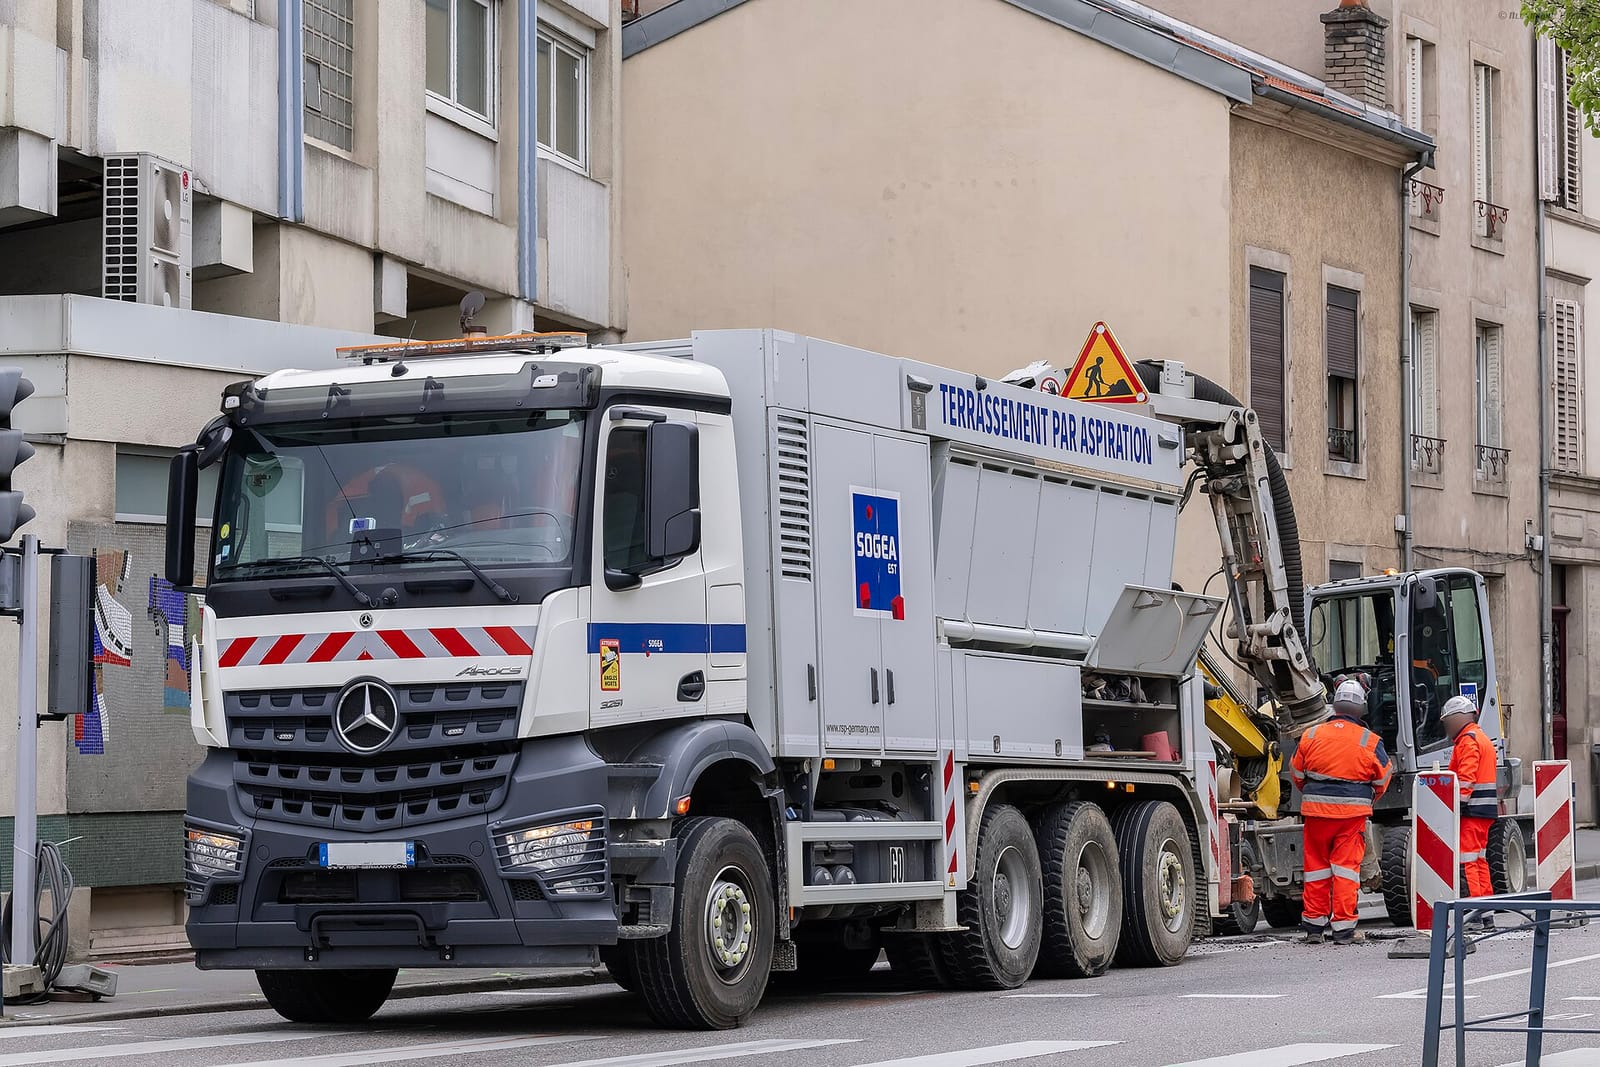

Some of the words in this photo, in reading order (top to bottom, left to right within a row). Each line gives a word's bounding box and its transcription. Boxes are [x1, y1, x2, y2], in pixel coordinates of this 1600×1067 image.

[183, 192, 189, 202] LG
[939, 383, 1049, 446] TERRASSEMENT
[1052, 410, 1077, 452] PAR
[1081, 416, 1152, 465] ASPIRATION
[856, 532, 897, 561] SOGEA
[887, 563, 897, 575] EST
[648, 639, 663, 647] SOGEA
[826, 724, 880, 735] www.rsp-germany.com
[406, 854, 415, 862] 54
